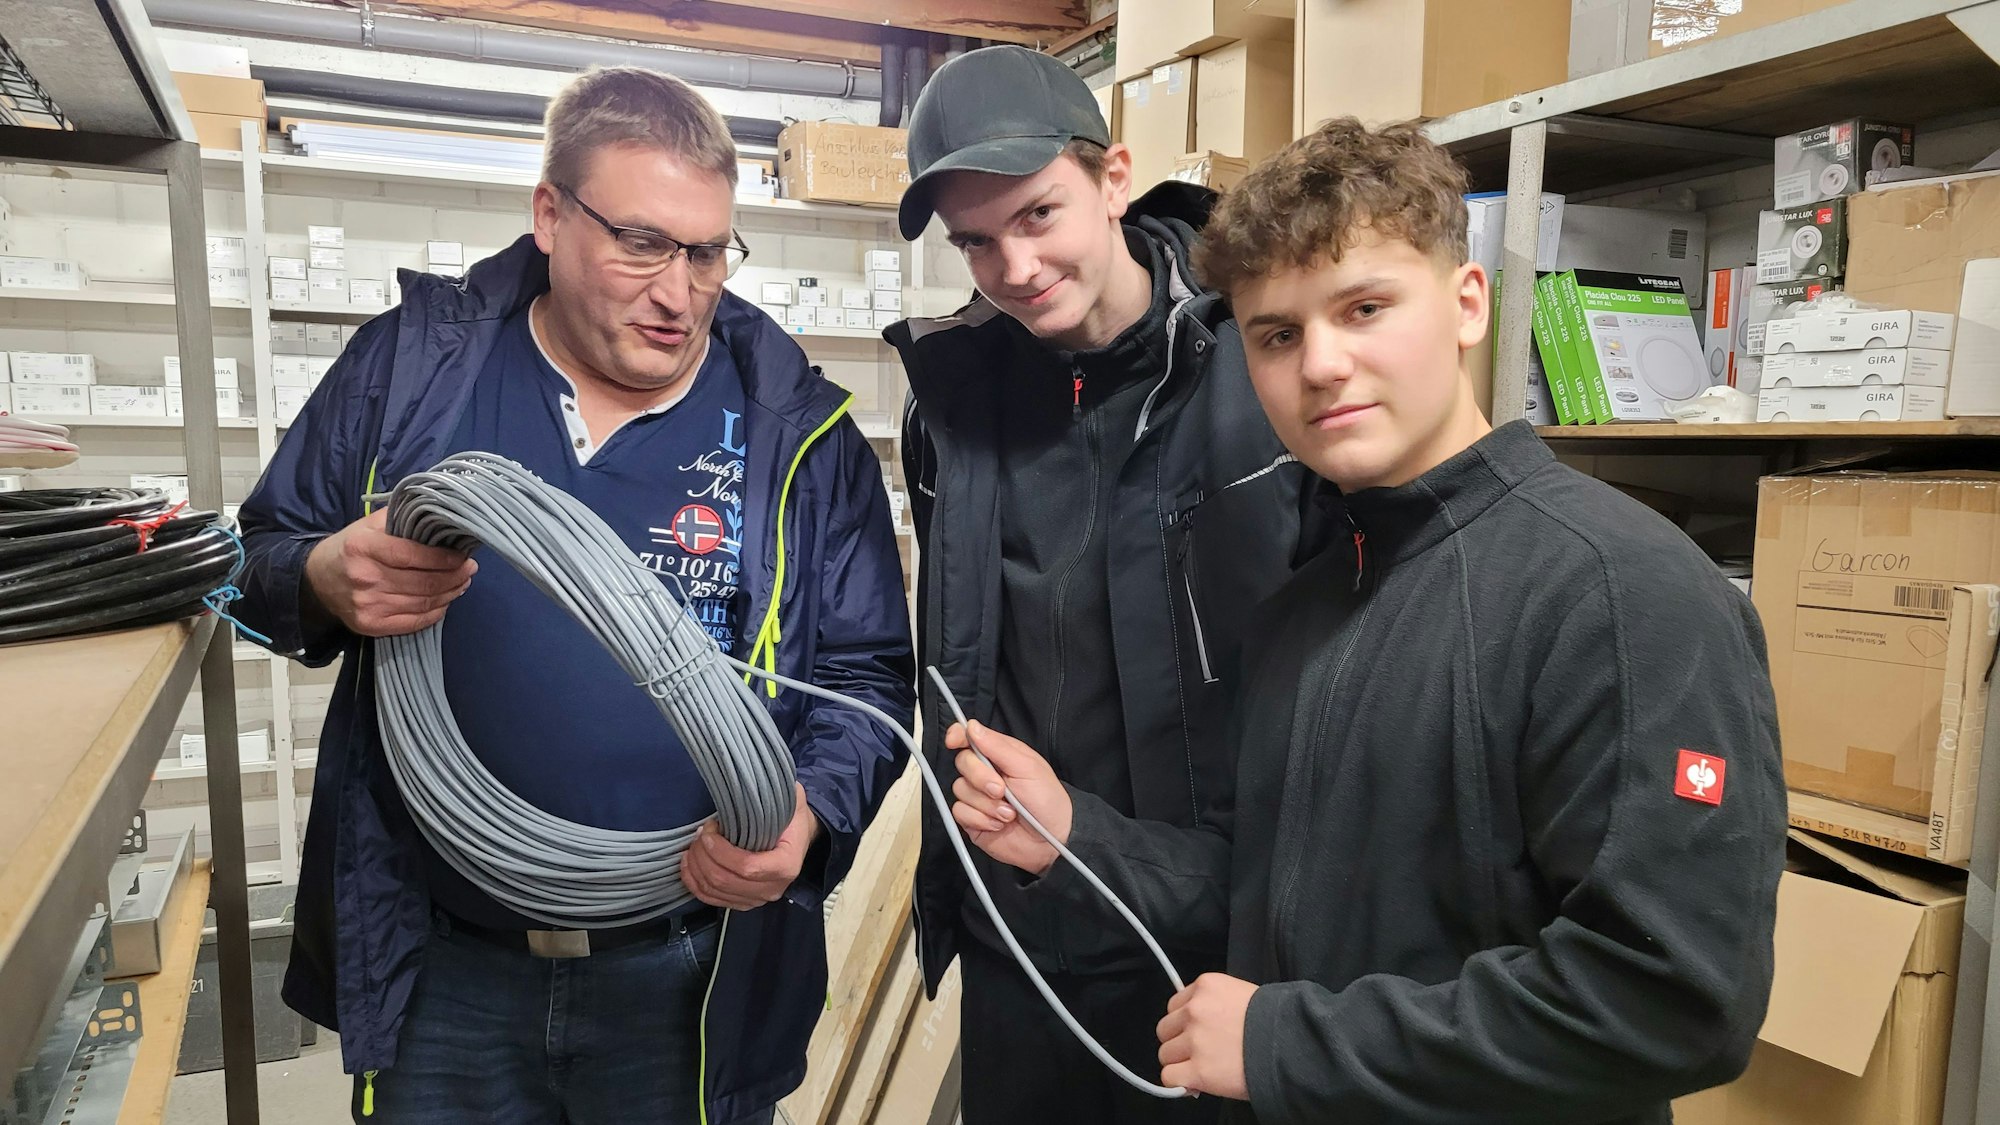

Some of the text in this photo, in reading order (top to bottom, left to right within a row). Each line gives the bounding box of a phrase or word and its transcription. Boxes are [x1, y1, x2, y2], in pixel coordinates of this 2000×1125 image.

[1798, 210, 1814, 219] LUX
[1547, 278, 1559, 307] Placida
[1555, 307, 1564, 325] Clou
[1566, 276, 1577, 305] Placida
[1574, 305, 1582, 324] Clou
[1584, 290, 1642, 303] Placida Clou 225
[1651, 295, 1686, 306] LED Panel
[1789, 286, 1804, 295] LUX
[1536, 310, 1545, 329] Clou
[1871, 321, 1899, 332] GIRA
[1867, 355, 1896, 365] GIRA
[1555, 379, 1572, 418] LED Panel
[1574, 377, 1591, 417] LED Panel
[1593, 376, 1609, 417] LED Panel
[1866, 393, 1895, 402] GIRA
[678, 450, 730, 477] North
[687, 477, 742, 504] Nor
[1812, 538, 1911, 573] Garcon
[1930, 811, 1945, 852] VA48T
[191, 979, 204, 993] 21
